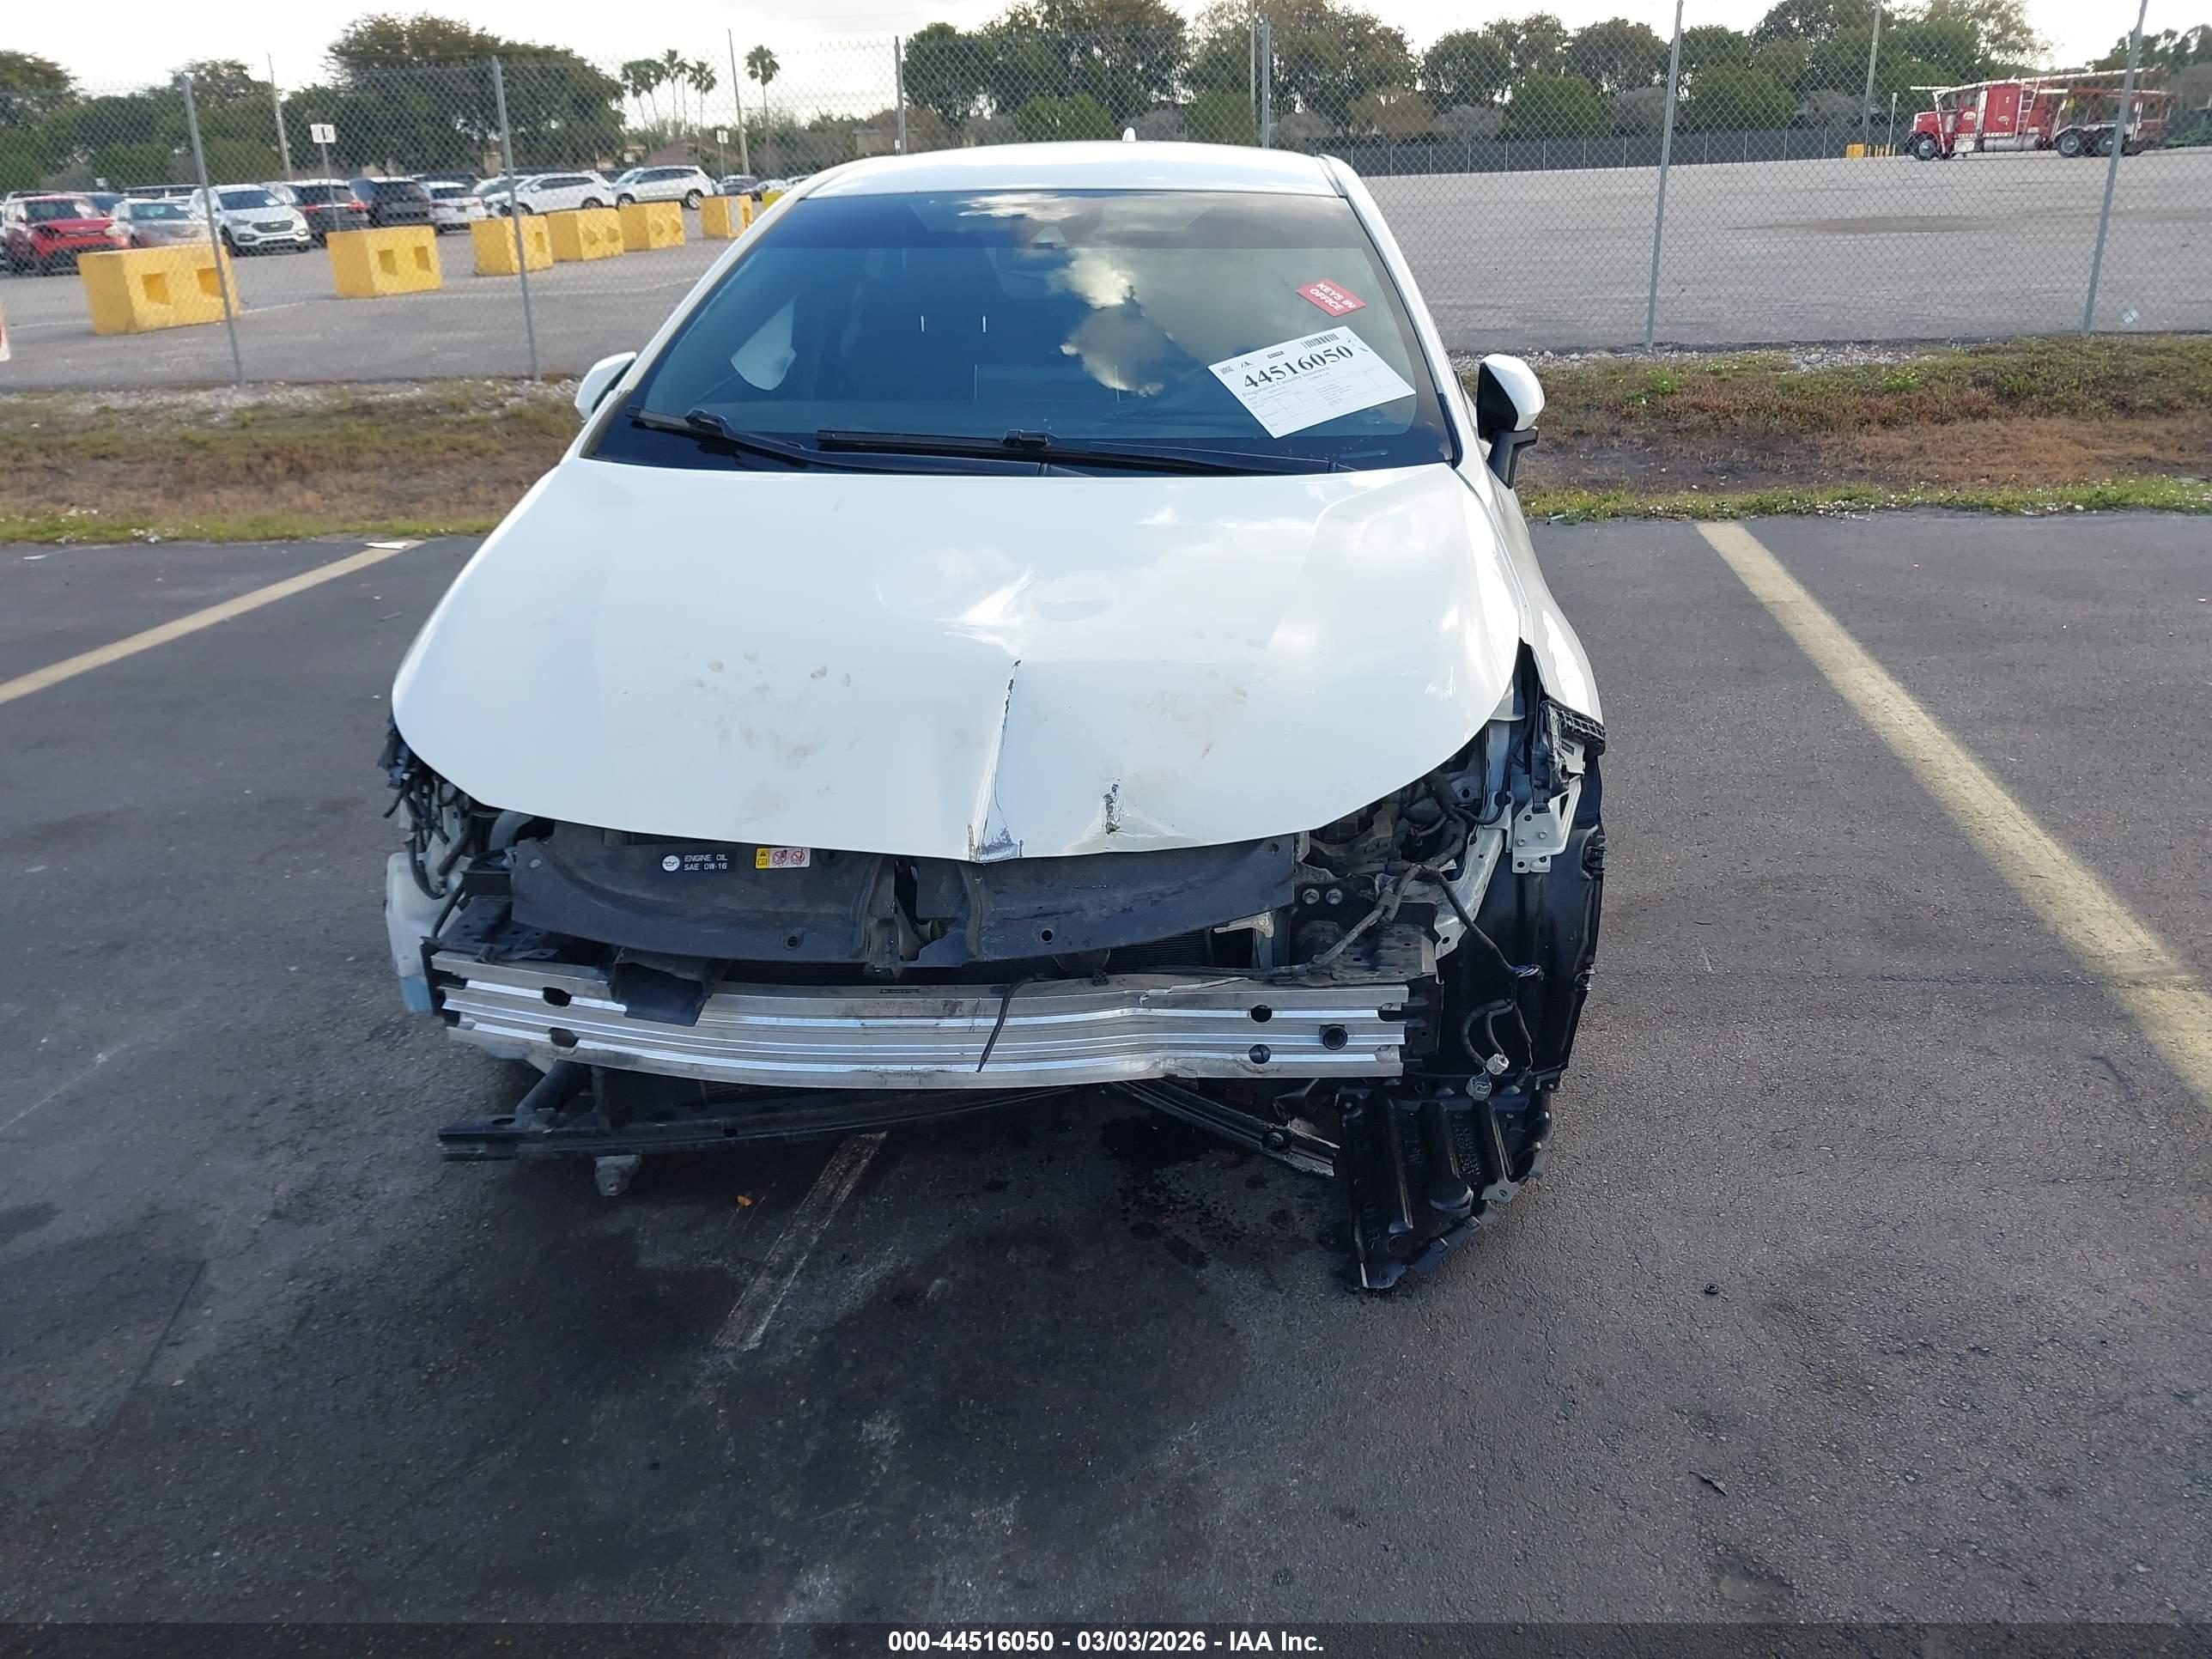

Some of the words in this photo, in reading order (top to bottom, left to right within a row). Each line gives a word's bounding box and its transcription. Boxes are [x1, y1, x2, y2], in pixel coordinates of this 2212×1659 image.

[1310, 289, 1345, 311] OFFICE
[1316, 283, 1344, 300] KEYS
[1342, 300, 1356, 308] IN
[1244, 345, 1353, 387] 44516050
